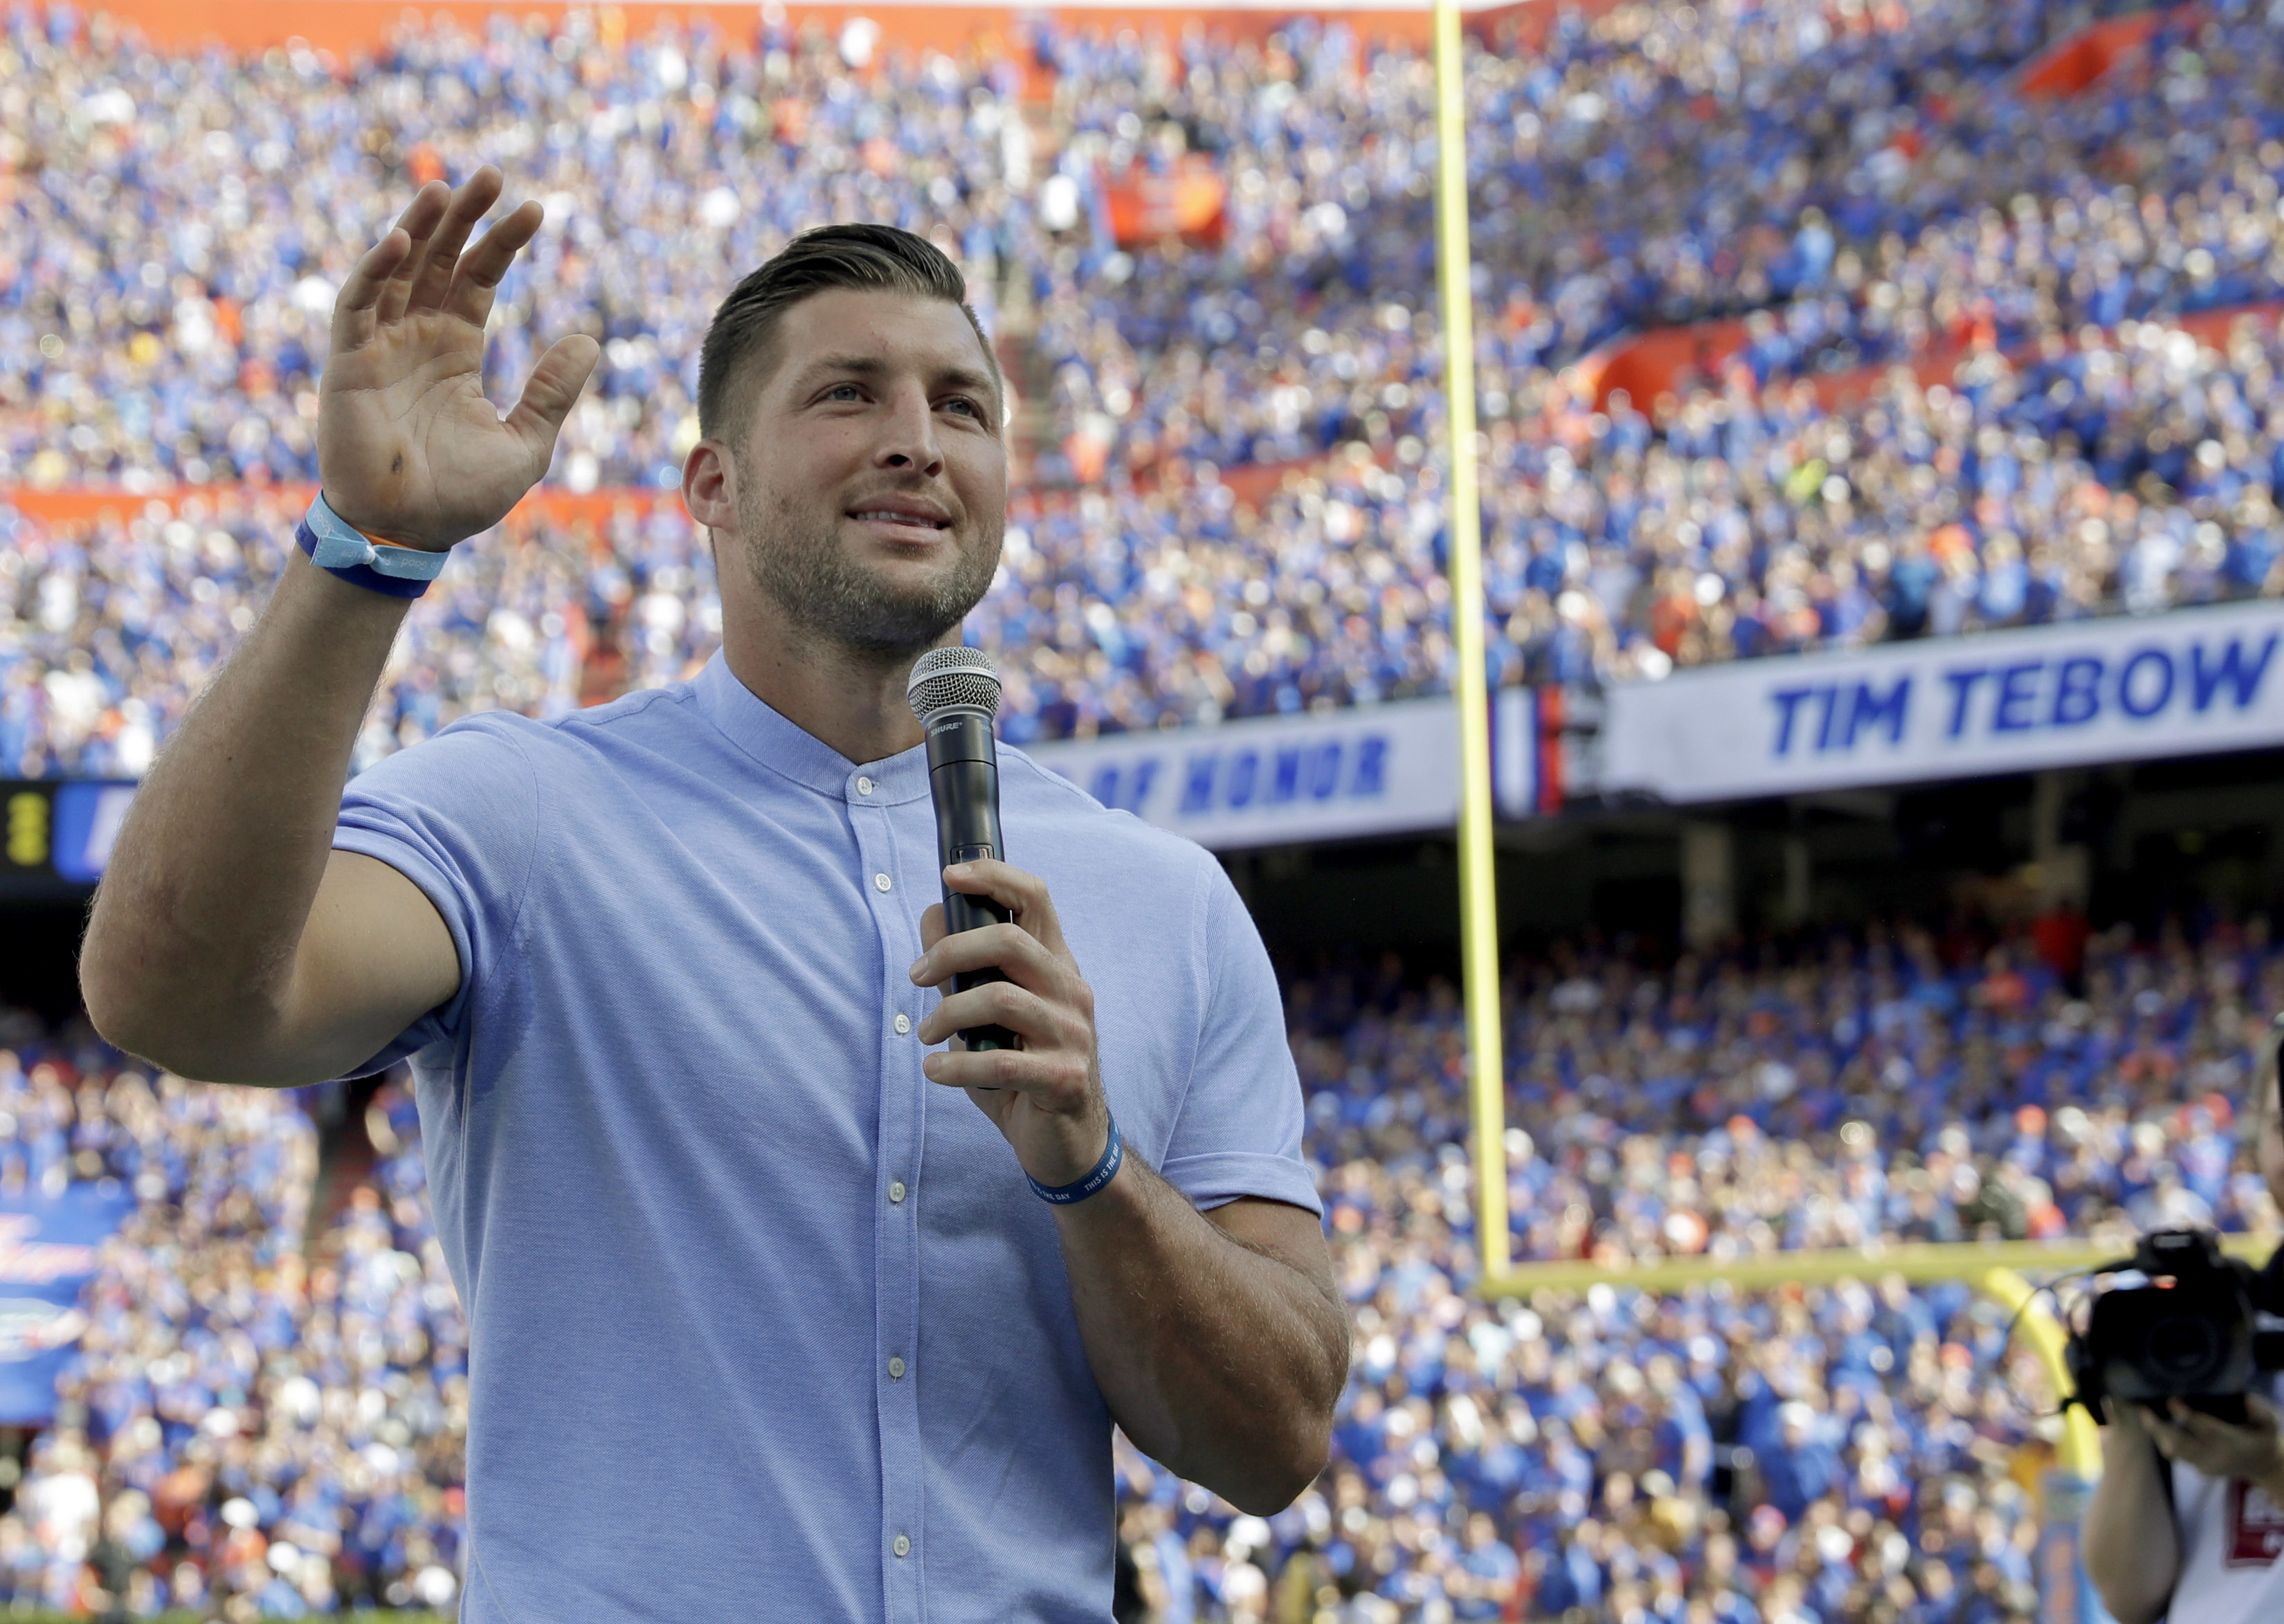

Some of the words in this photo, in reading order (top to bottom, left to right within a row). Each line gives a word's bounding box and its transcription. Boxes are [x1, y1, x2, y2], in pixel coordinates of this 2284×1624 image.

[401, 558, 428, 570] Good
[1769, 675, 1910, 756] TIM
[1945, 632, 2278, 738] TEBOW
[930, 722, 959, 738] SHURE
[1179, 735, 1388, 812] HONOR
[1083, 1176, 1102, 1192] THIS
[1100, 1168, 1109, 1178] IS
[1105, 1155, 1117, 1171] THE
